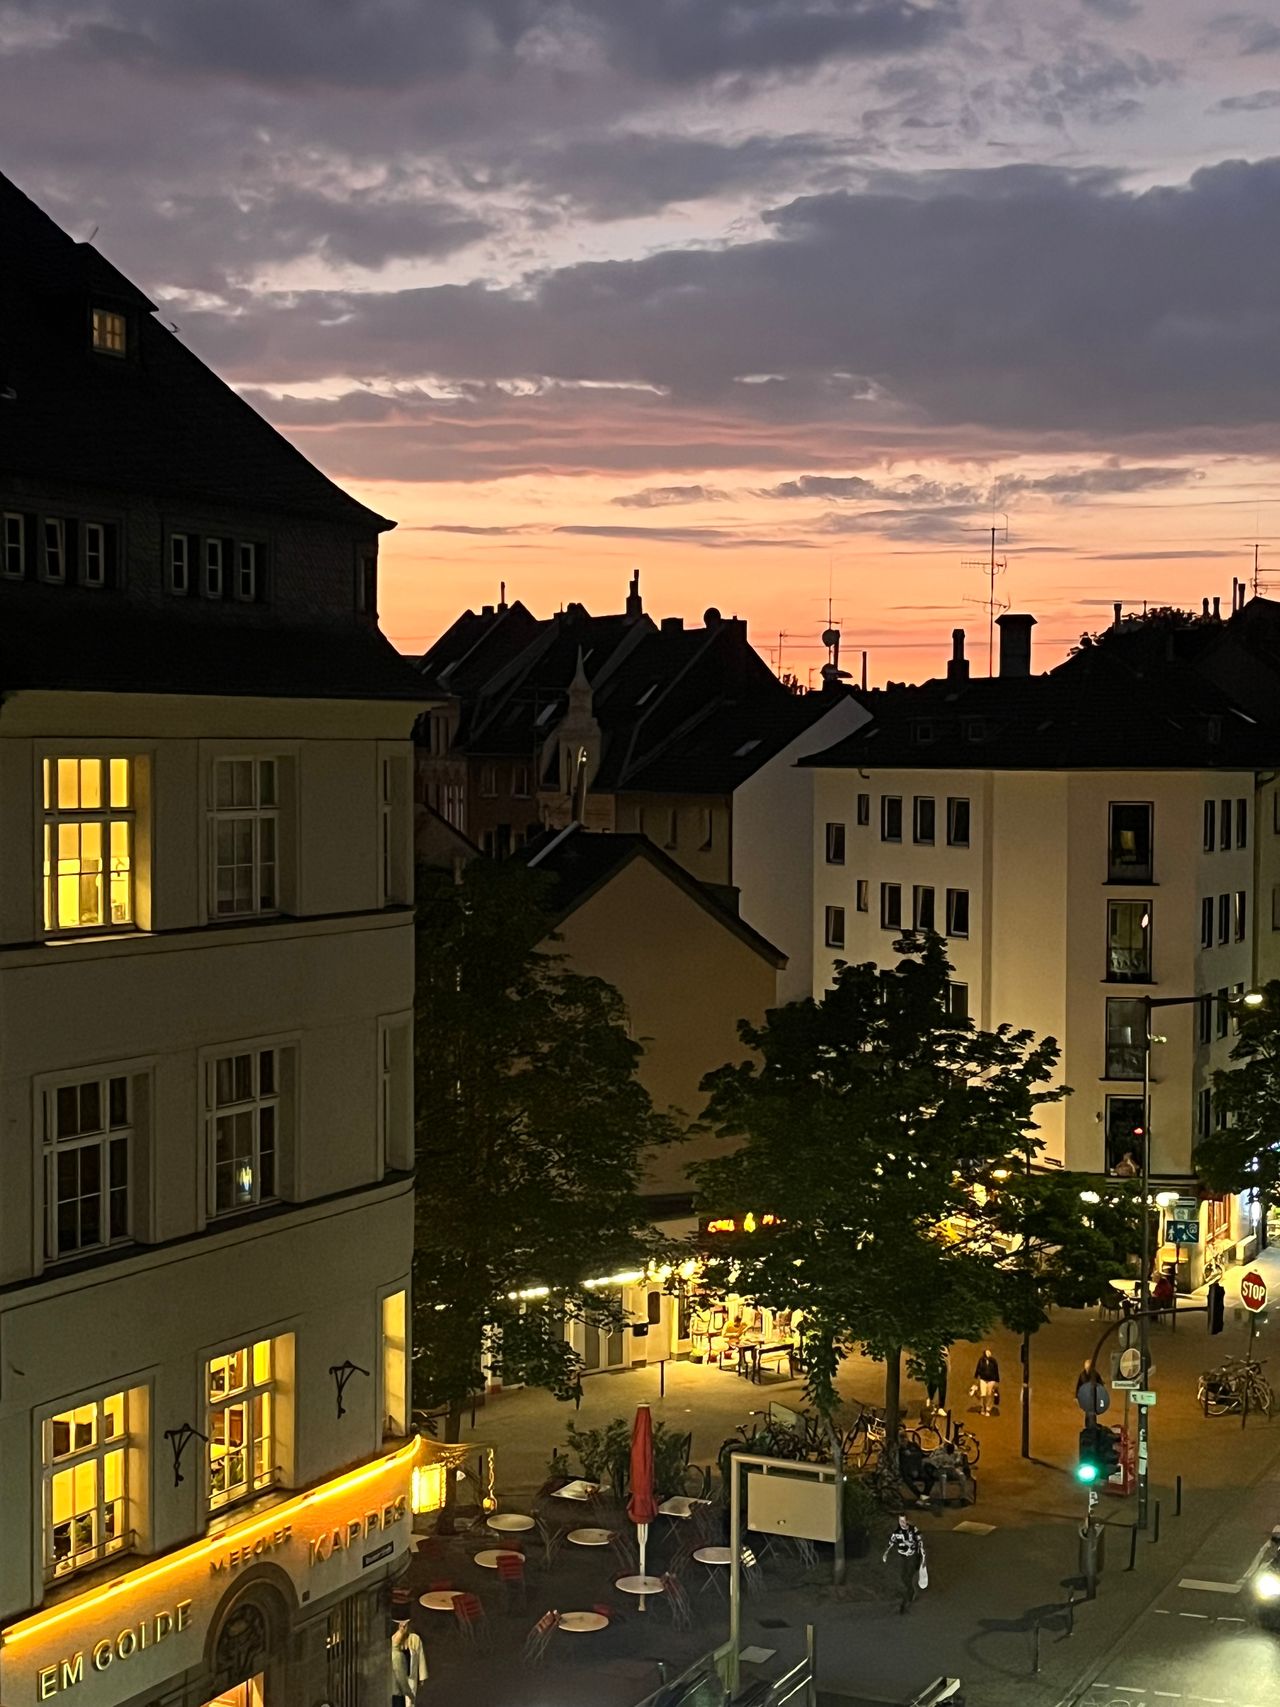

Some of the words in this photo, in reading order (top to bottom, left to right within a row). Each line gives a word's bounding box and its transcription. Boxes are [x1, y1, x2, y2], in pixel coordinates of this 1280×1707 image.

[1242, 1280, 1266, 1302] STOP
[38, 1651, 83, 1701] EM
[308, 1494, 406, 1568] KAPPES
